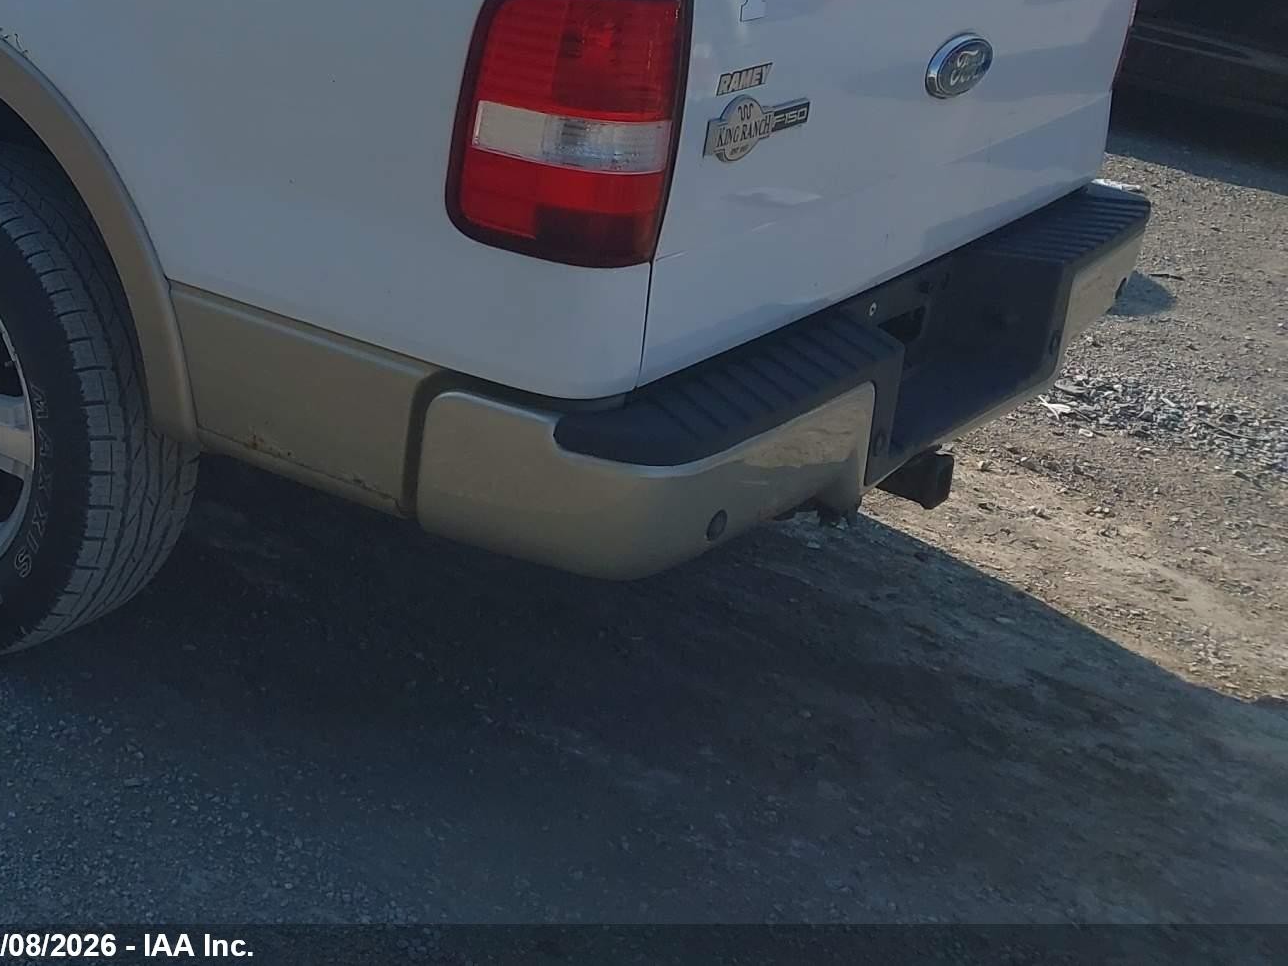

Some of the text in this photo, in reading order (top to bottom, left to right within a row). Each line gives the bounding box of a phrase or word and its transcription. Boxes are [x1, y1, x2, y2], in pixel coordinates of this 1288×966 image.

[717, 63, 773, 96] RAMEY
[715, 113, 772, 148] KING RANCH
[14, 383, 55, 579] MAXXIS
